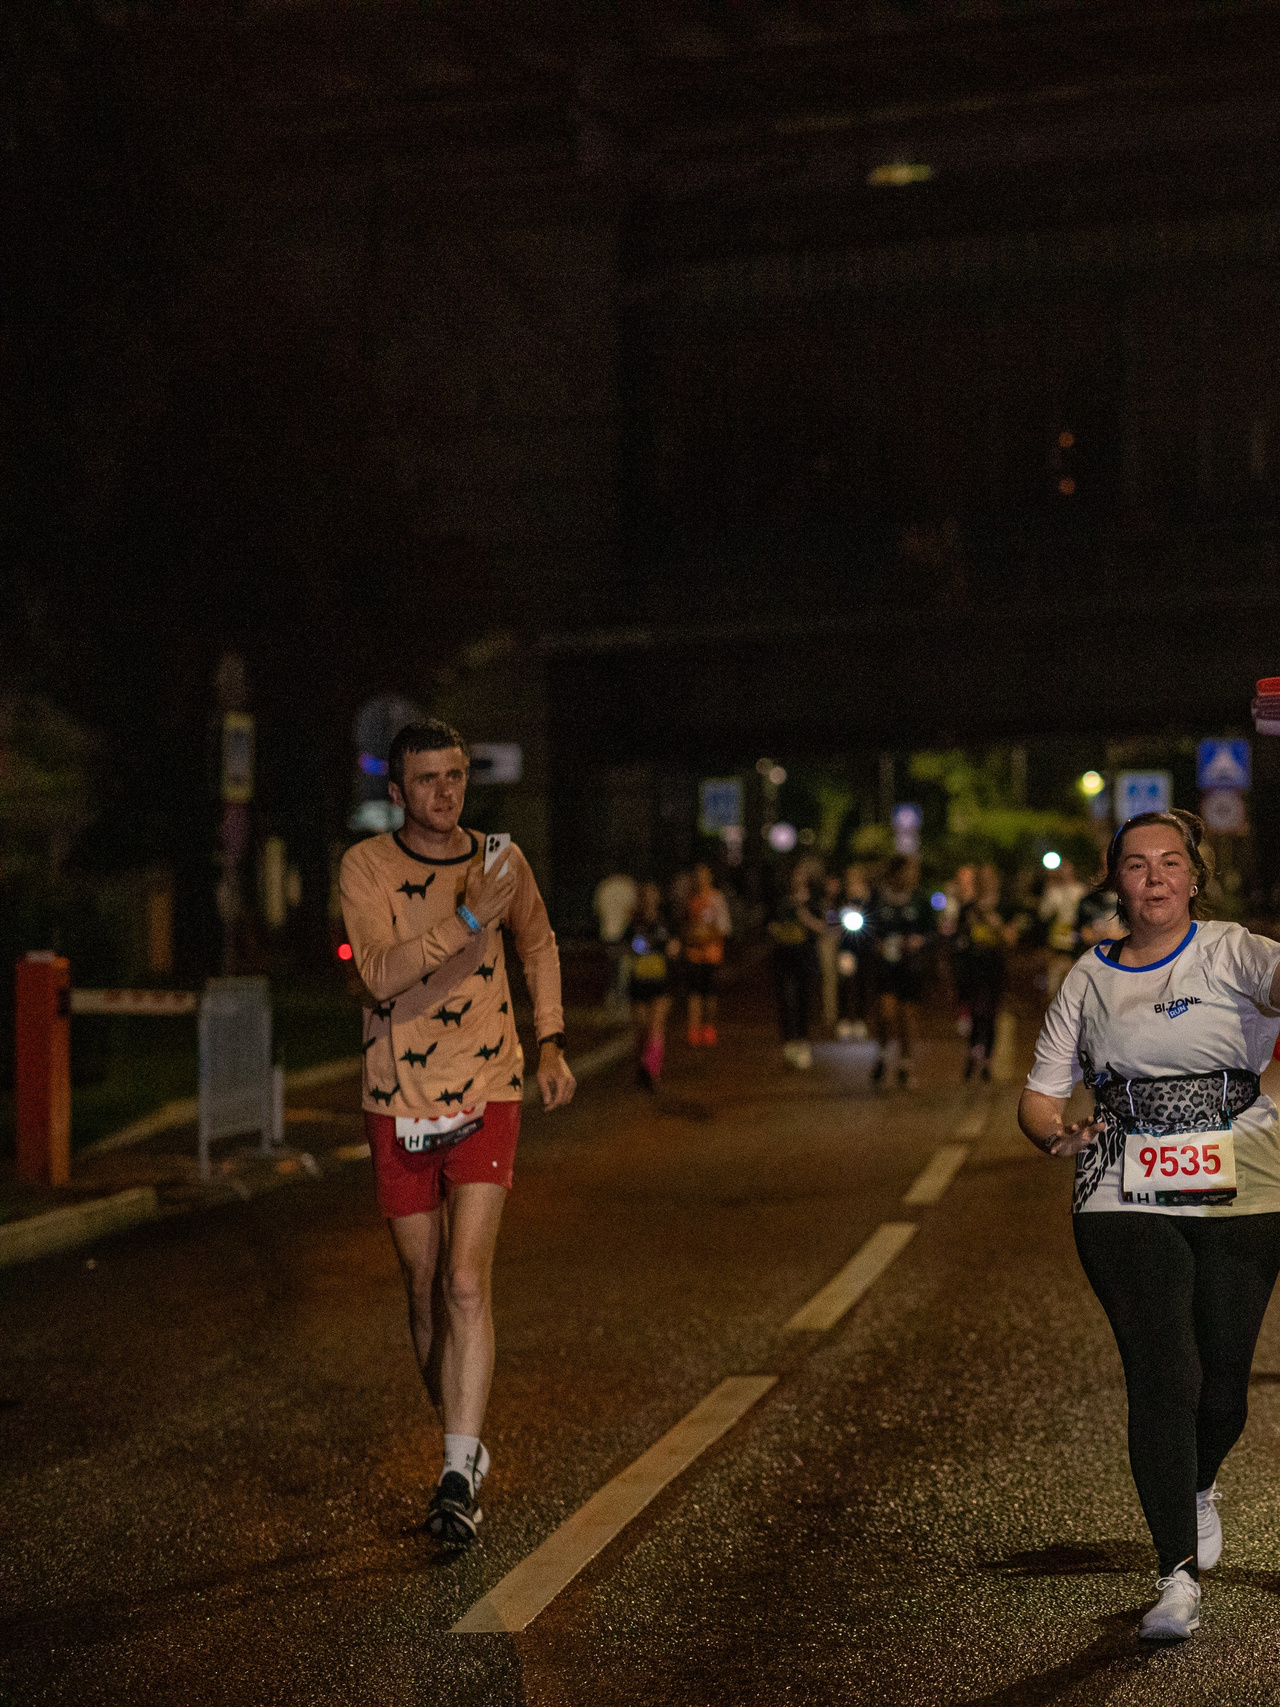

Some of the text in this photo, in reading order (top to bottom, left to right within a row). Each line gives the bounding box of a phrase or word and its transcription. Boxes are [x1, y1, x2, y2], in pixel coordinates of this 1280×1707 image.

[1154, 996, 1202, 1013] BI.ZONE
[1169, 1005, 1186, 1018] RUN
[1139, 1145, 1221, 1178] 9535
[1137, 1192, 1149, 1203] H
